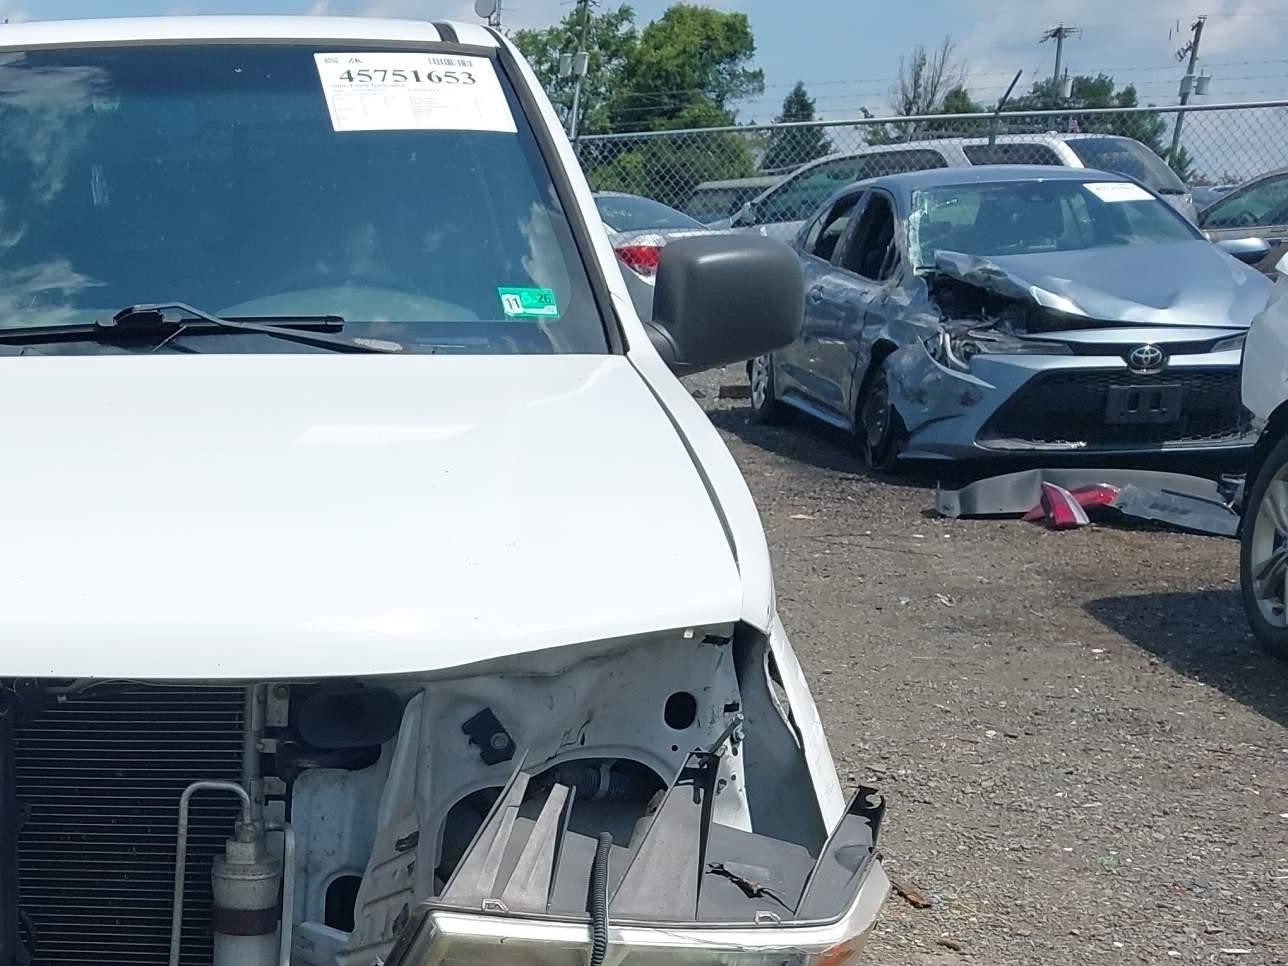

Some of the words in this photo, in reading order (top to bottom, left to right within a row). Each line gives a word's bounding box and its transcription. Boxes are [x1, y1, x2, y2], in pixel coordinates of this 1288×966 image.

[339, 69, 476, 85] 45751653
[505, 297, 520, 310] 11
[536, 293, 552, 304] 26
